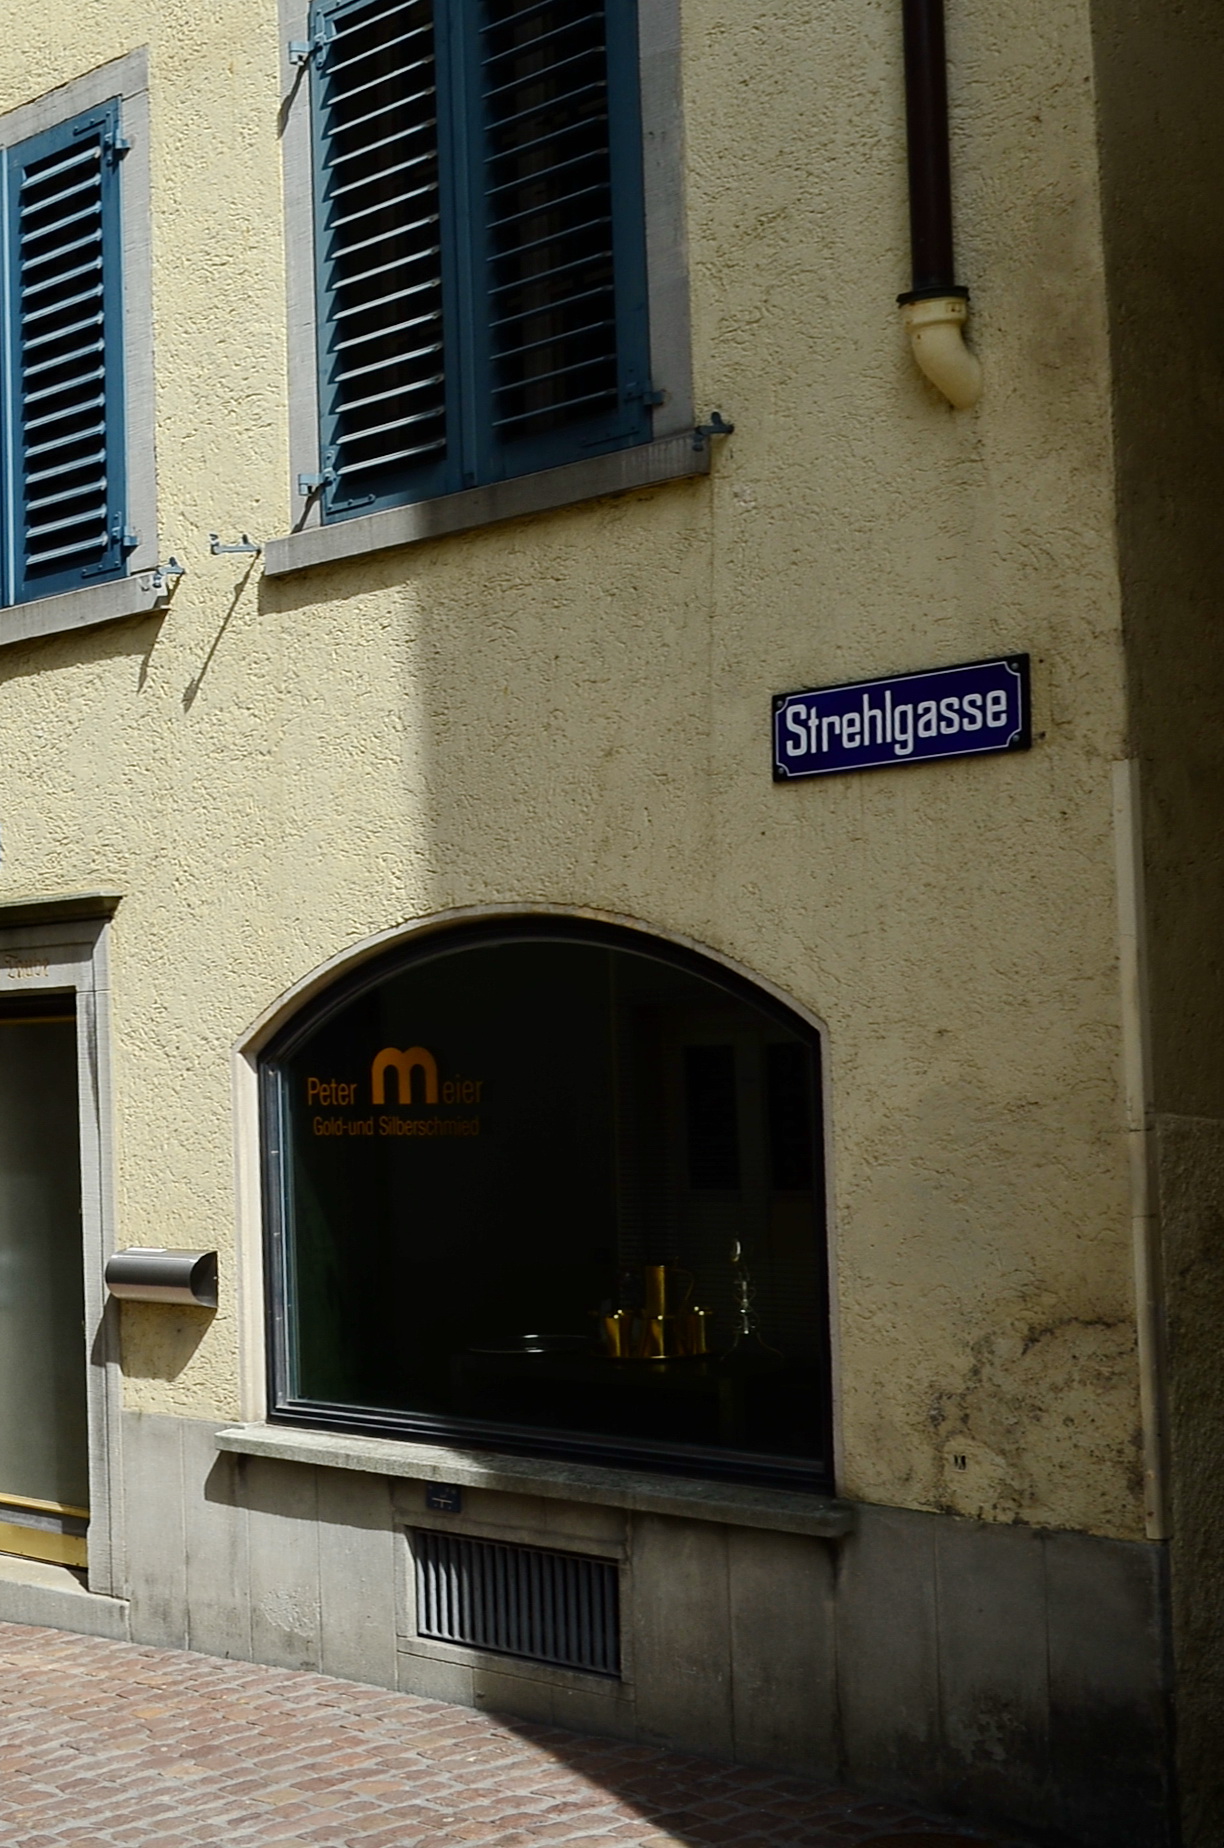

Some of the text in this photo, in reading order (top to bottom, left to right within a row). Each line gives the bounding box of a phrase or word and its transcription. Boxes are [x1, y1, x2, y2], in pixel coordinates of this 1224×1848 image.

[785, 690, 1008, 756] Strehlgasse
[307, 1077, 358, 1106] Peter
[379, 1114, 480, 1137] Silberschmied
